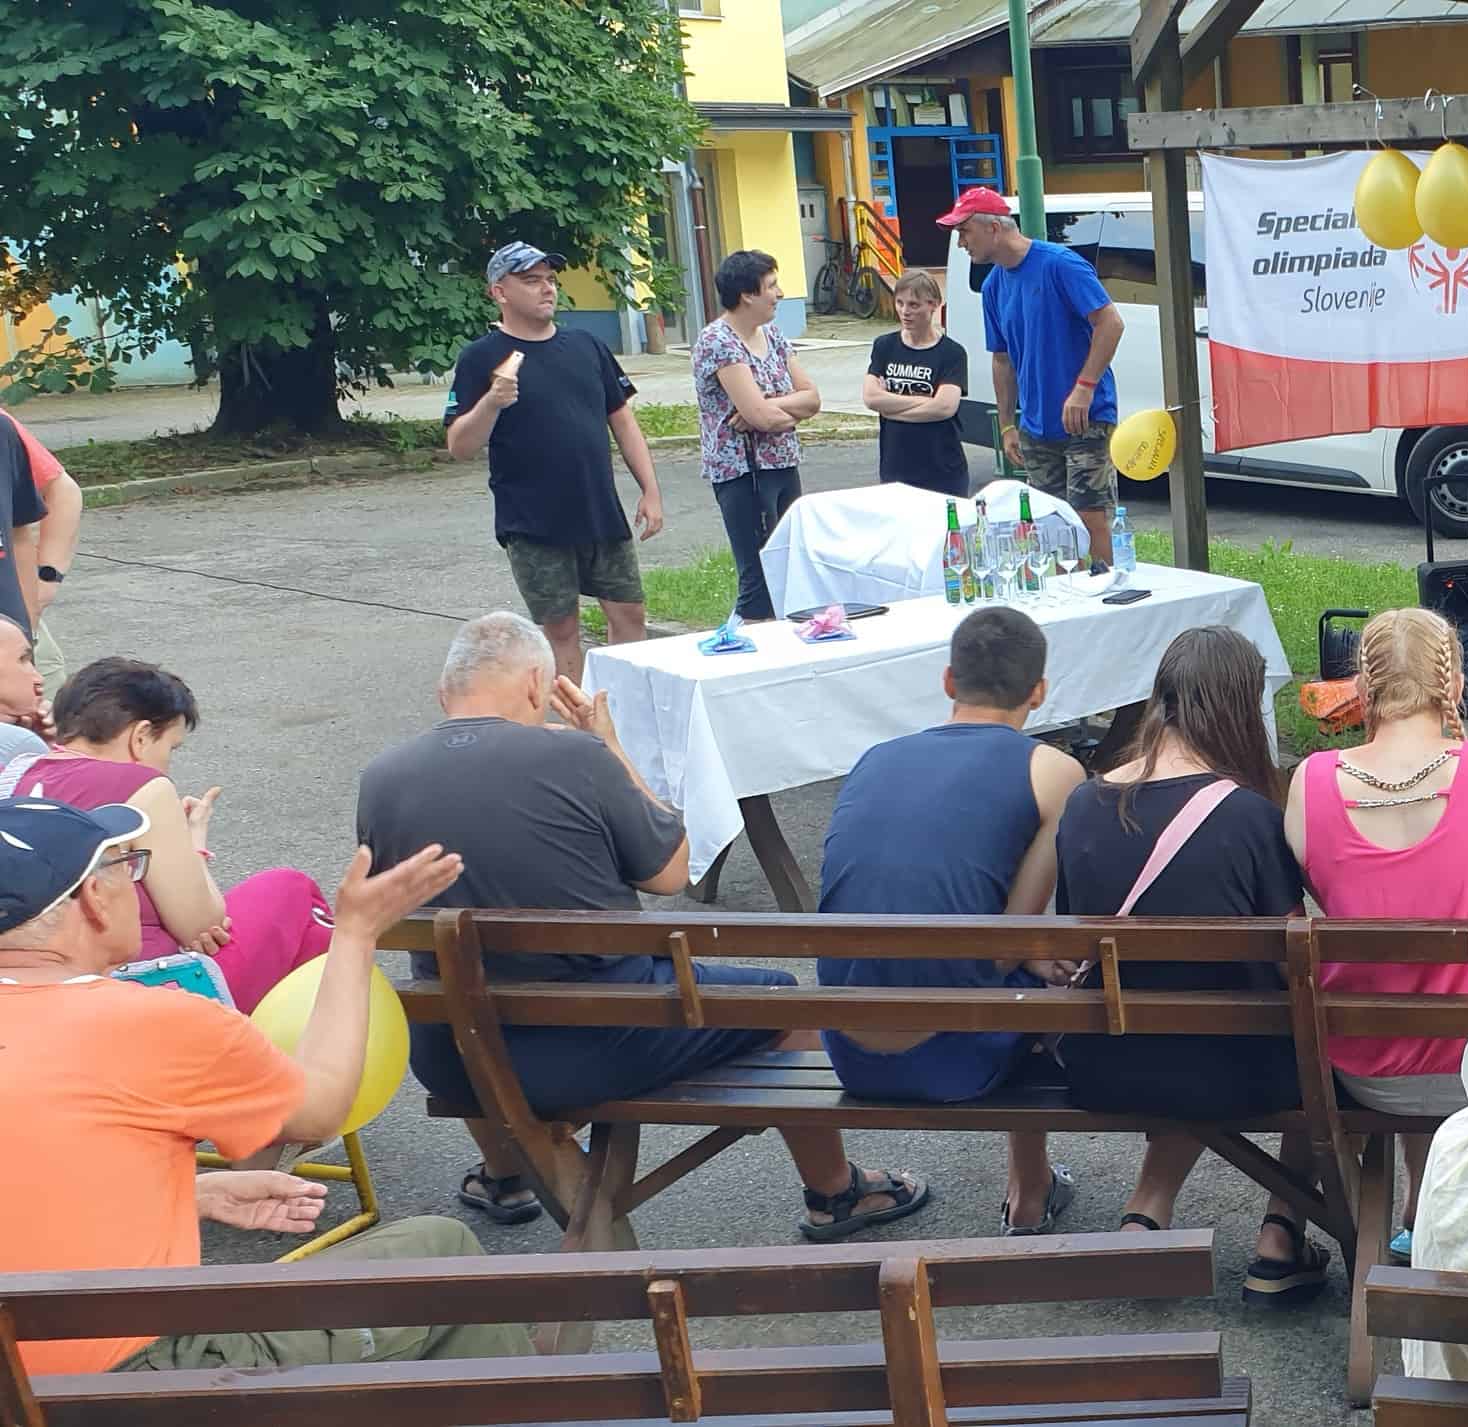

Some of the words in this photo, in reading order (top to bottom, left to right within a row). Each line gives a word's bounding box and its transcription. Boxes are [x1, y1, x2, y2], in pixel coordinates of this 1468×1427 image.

[1257, 206, 1358, 240] Special
[1253, 245, 1387, 276] olimpiada
[1300, 281, 1386, 313] Slovenije
[885, 363, 933, 381] SUMMER
